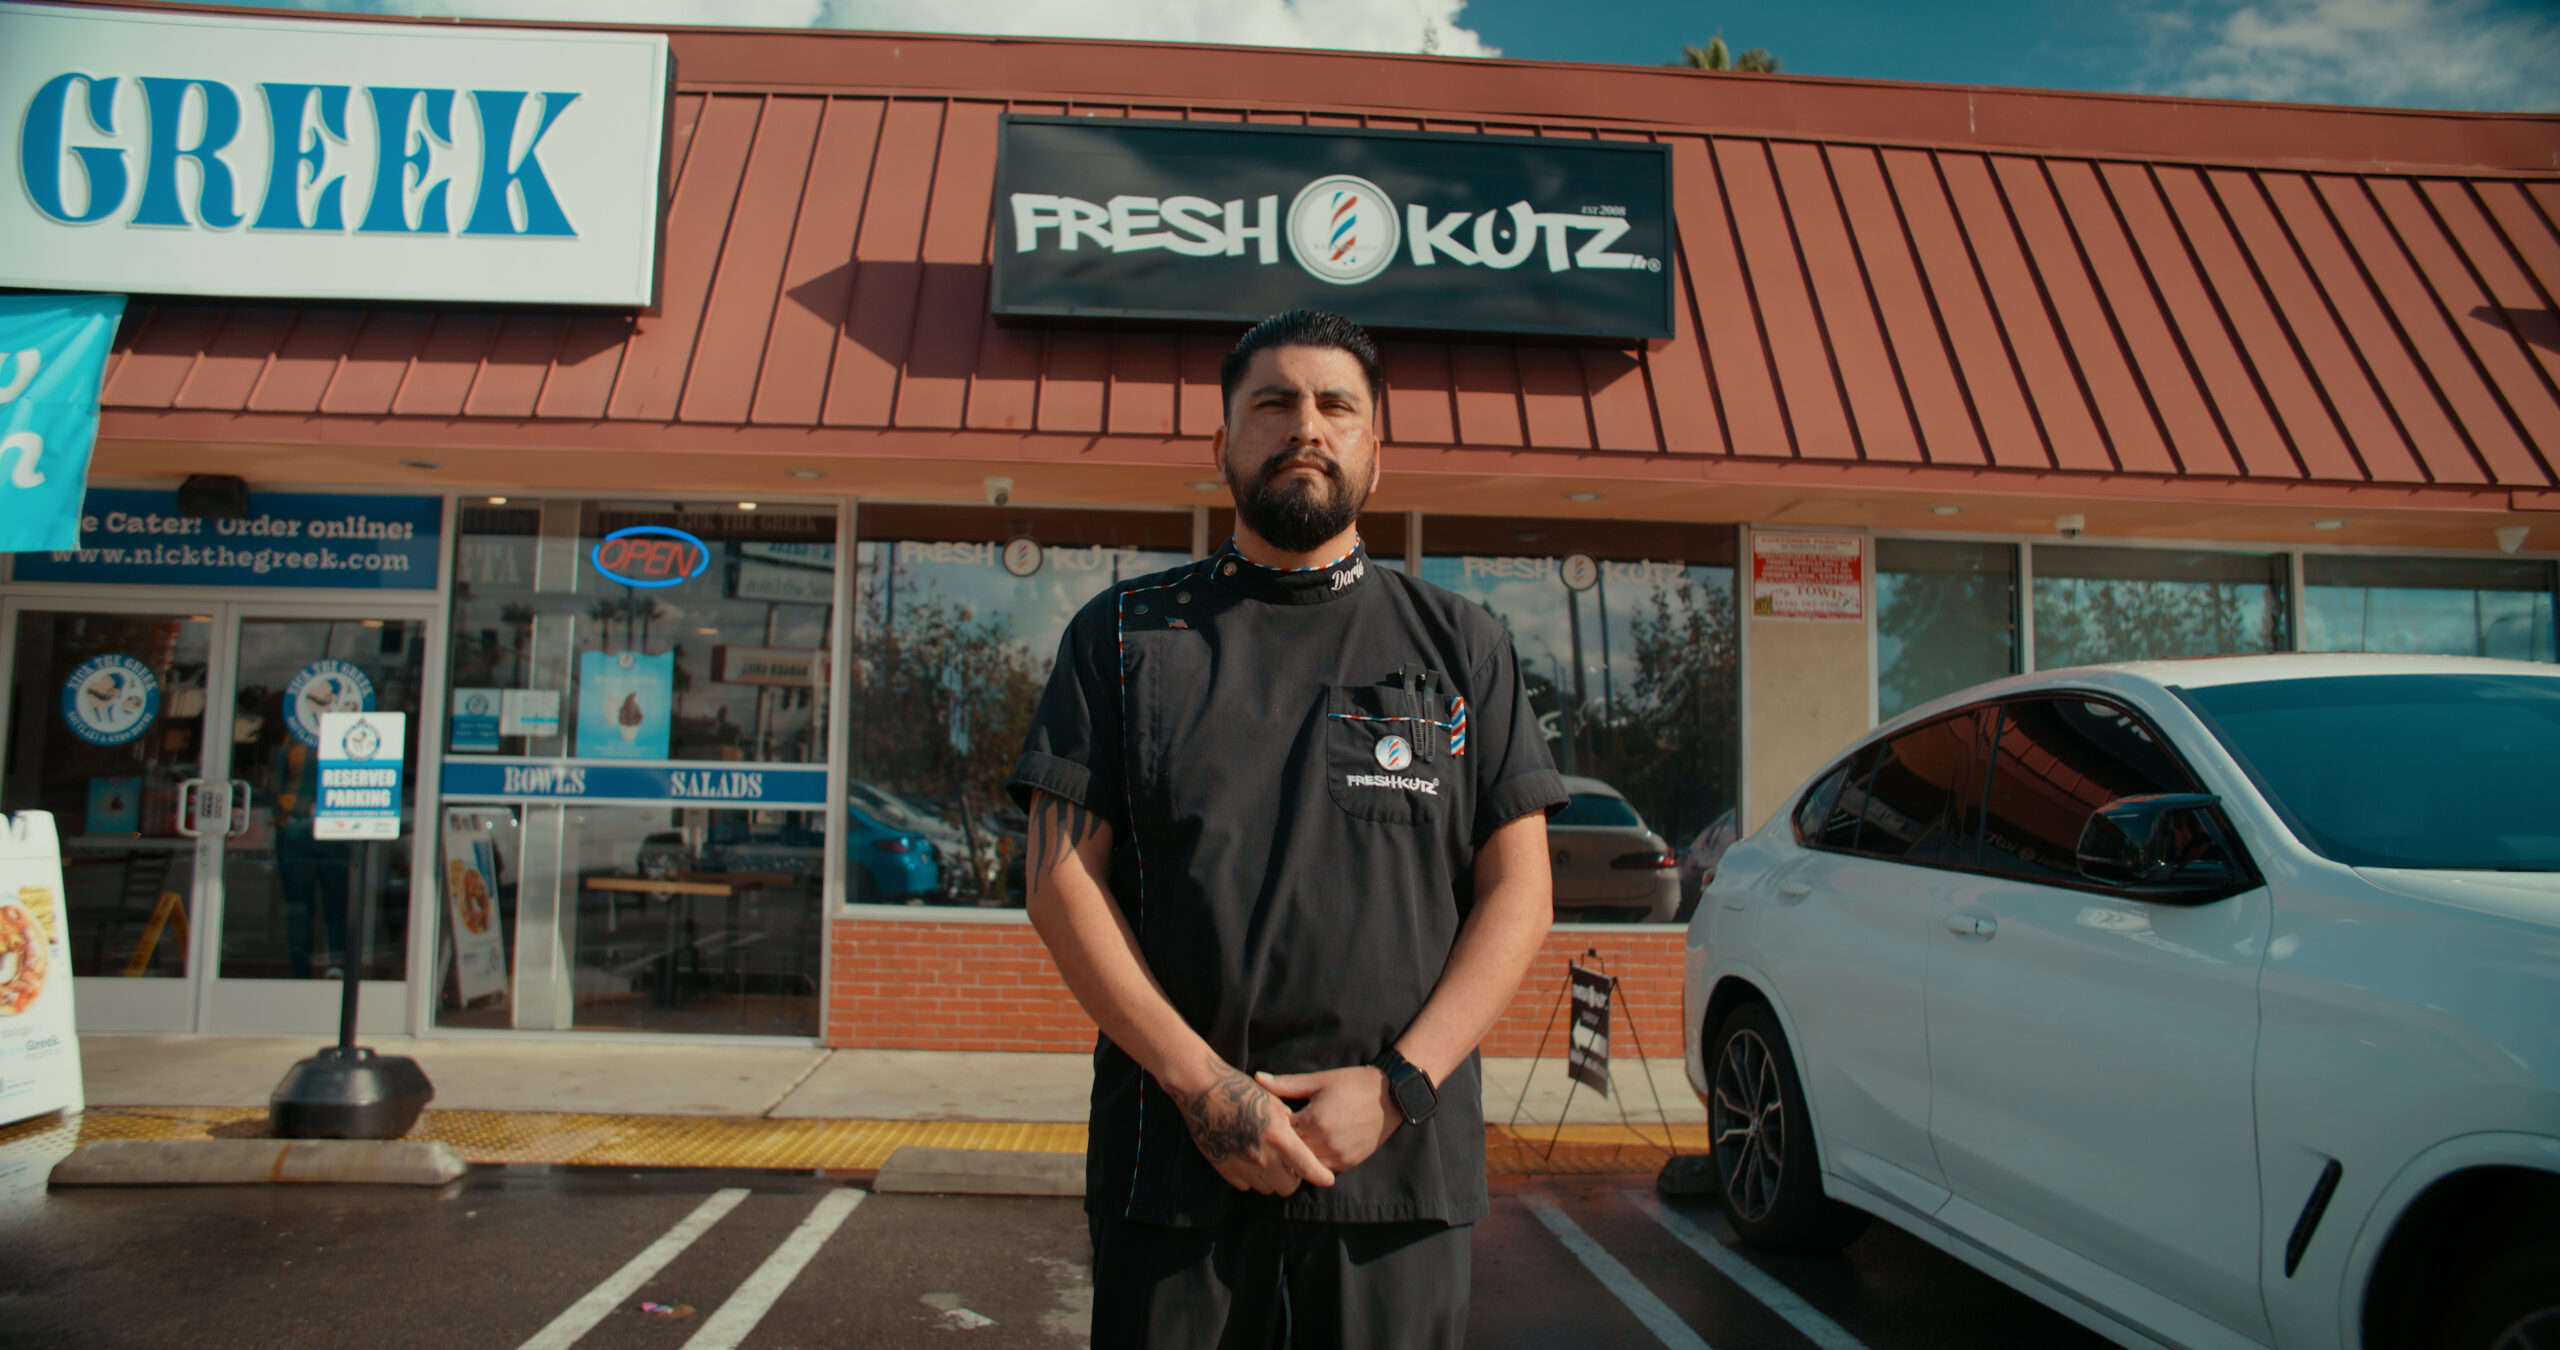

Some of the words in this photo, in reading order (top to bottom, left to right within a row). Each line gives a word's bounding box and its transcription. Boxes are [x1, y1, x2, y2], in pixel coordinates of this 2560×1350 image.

[20, 71, 582, 238] GREEK
[1010, 193, 1279, 265] FRESH
[307, 516, 413, 541] online:
[51, 546, 410, 574] www.nickthegreek.com
[598, 537, 700, 577] OPEN
[899, 540, 995, 567] FRESH
[1462, 555, 1555, 580] FRESH
[124, 658, 158, 693] GREEK
[321, 768, 397, 787] RESERVED
[503, 765, 586, 795] BOWLS
[670, 769, 763, 799] SALADS
[324, 788, 392, 808] PARKING
